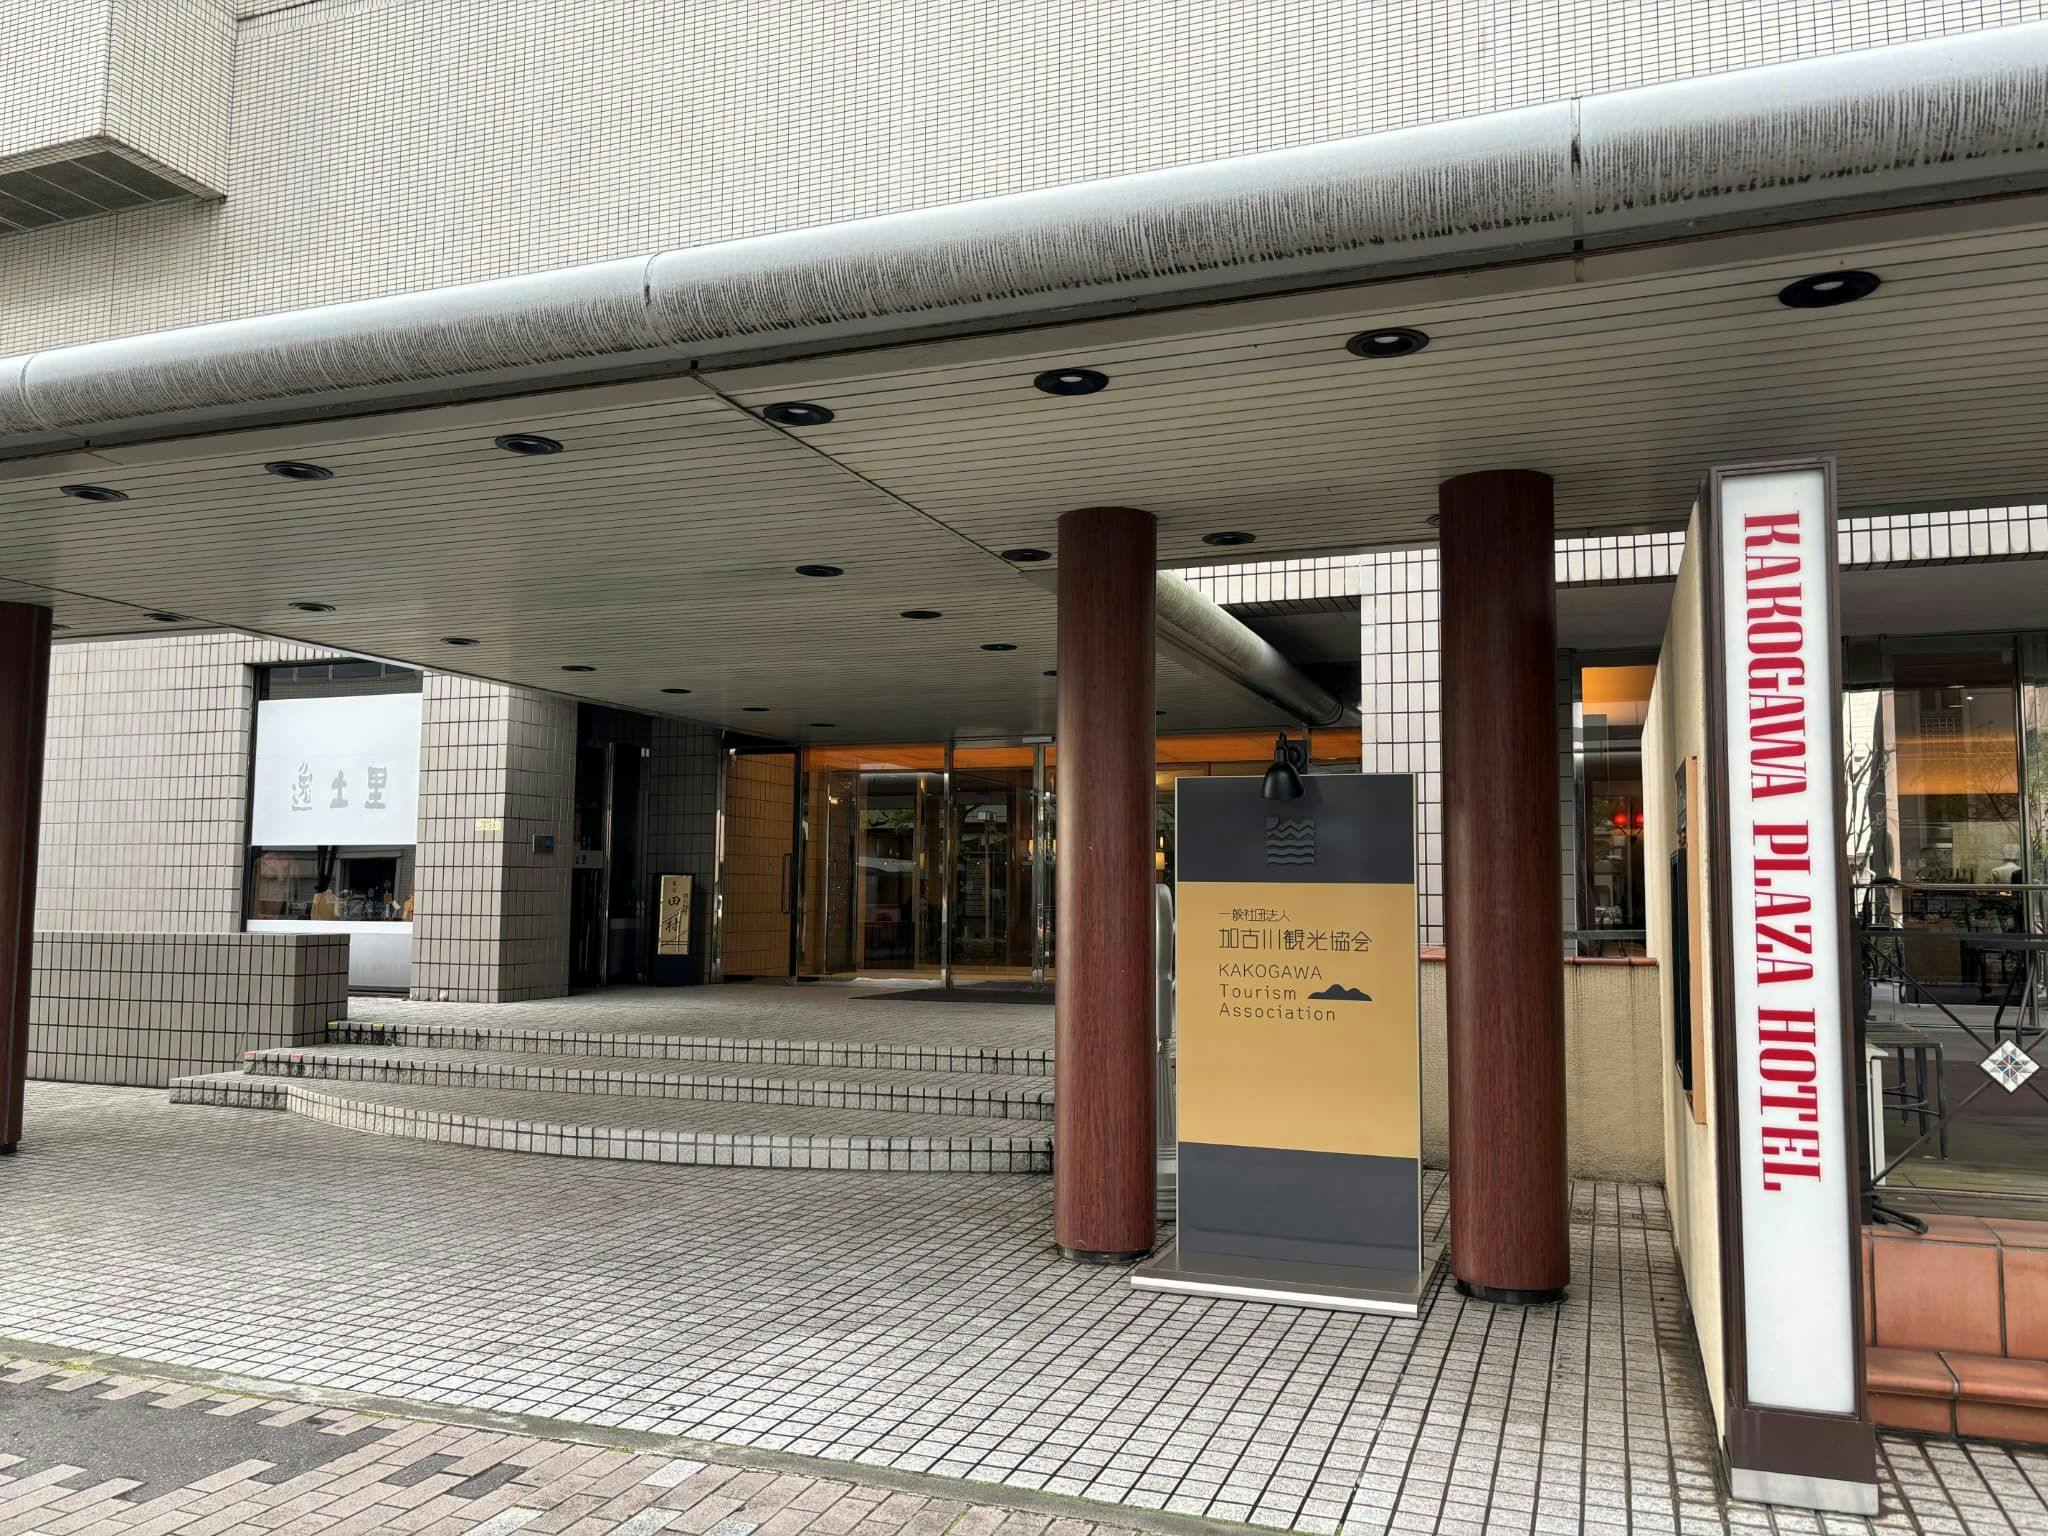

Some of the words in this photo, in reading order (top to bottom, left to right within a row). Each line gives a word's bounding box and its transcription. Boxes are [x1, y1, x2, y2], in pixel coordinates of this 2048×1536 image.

[1744, 510, 1807, 802] KAKOGAWA
[1753, 820, 1814, 987] PLAZA
[1218, 908, 1291, 922] 一般社団法人
[1218, 928, 1373, 952] 加古川観光協会
[1219, 963, 1323, 980] KAKOGAWA
[1219, 984, 1297, 1000] Tourism
[1219, 1002, 1336, 1021] Association
[1758, 1005, 1821, 1191] HOTEL
